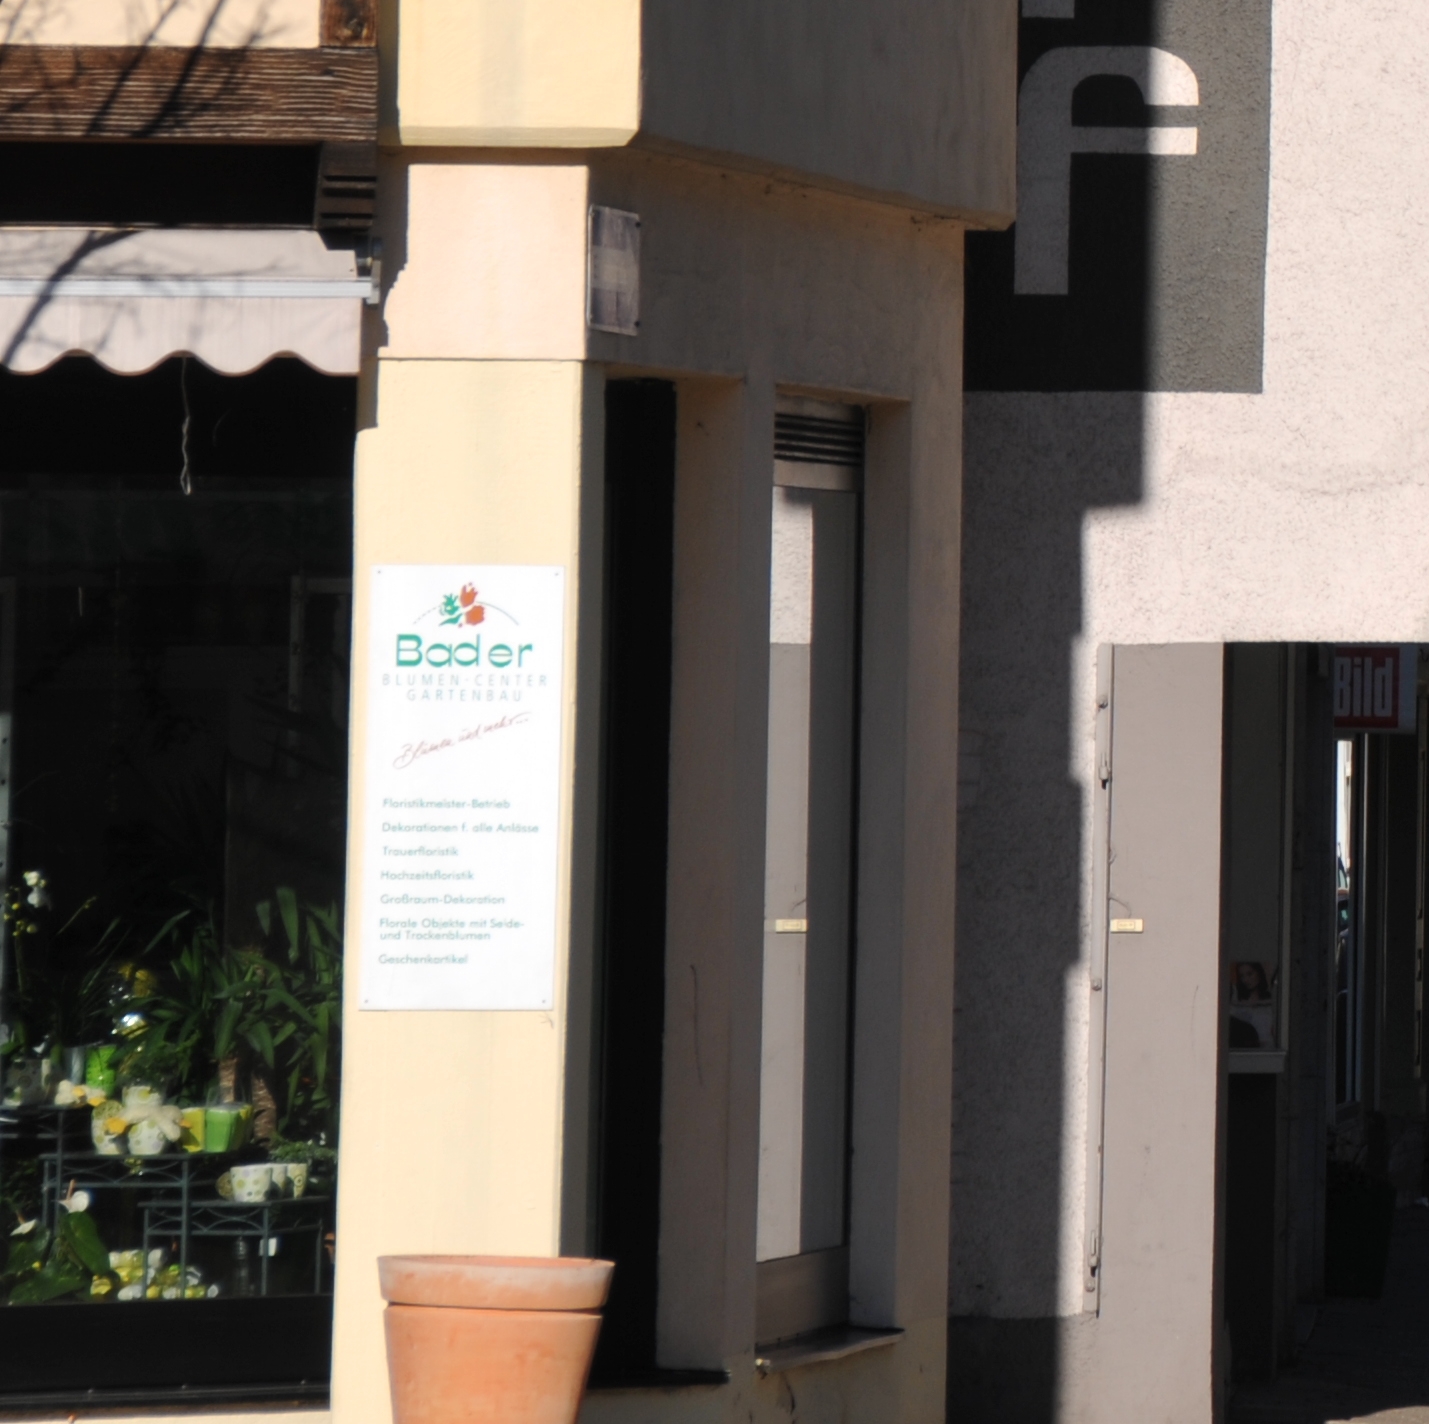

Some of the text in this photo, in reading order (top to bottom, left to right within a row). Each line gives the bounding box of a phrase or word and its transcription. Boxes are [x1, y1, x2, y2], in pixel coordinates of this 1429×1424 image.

[395, 633, 534, 669] Bader
[1334, 656, 1394, 718] Bild
[406, 688, 523, 702] GARTENBAU
[381, 822, 459, 833] Dekorationen
[472, 822, 494, 833] alle
[496, 822, 540, 833] Anlässe
[382, 845, 460, 857] Trauerfloristik
[380, 869, 475, 881] Hochzeitsfloristik
[380, 893, 506, 905] Großraum-Dekoration
[379, 917, 419, 929] Florale
[421, 917, 466, 930] Objekte
[469, 918, 488, 928] mit
[380, 930, 491, 941] und Trockenblumen
[378, 953, 469, 965] Geschenkartikel
